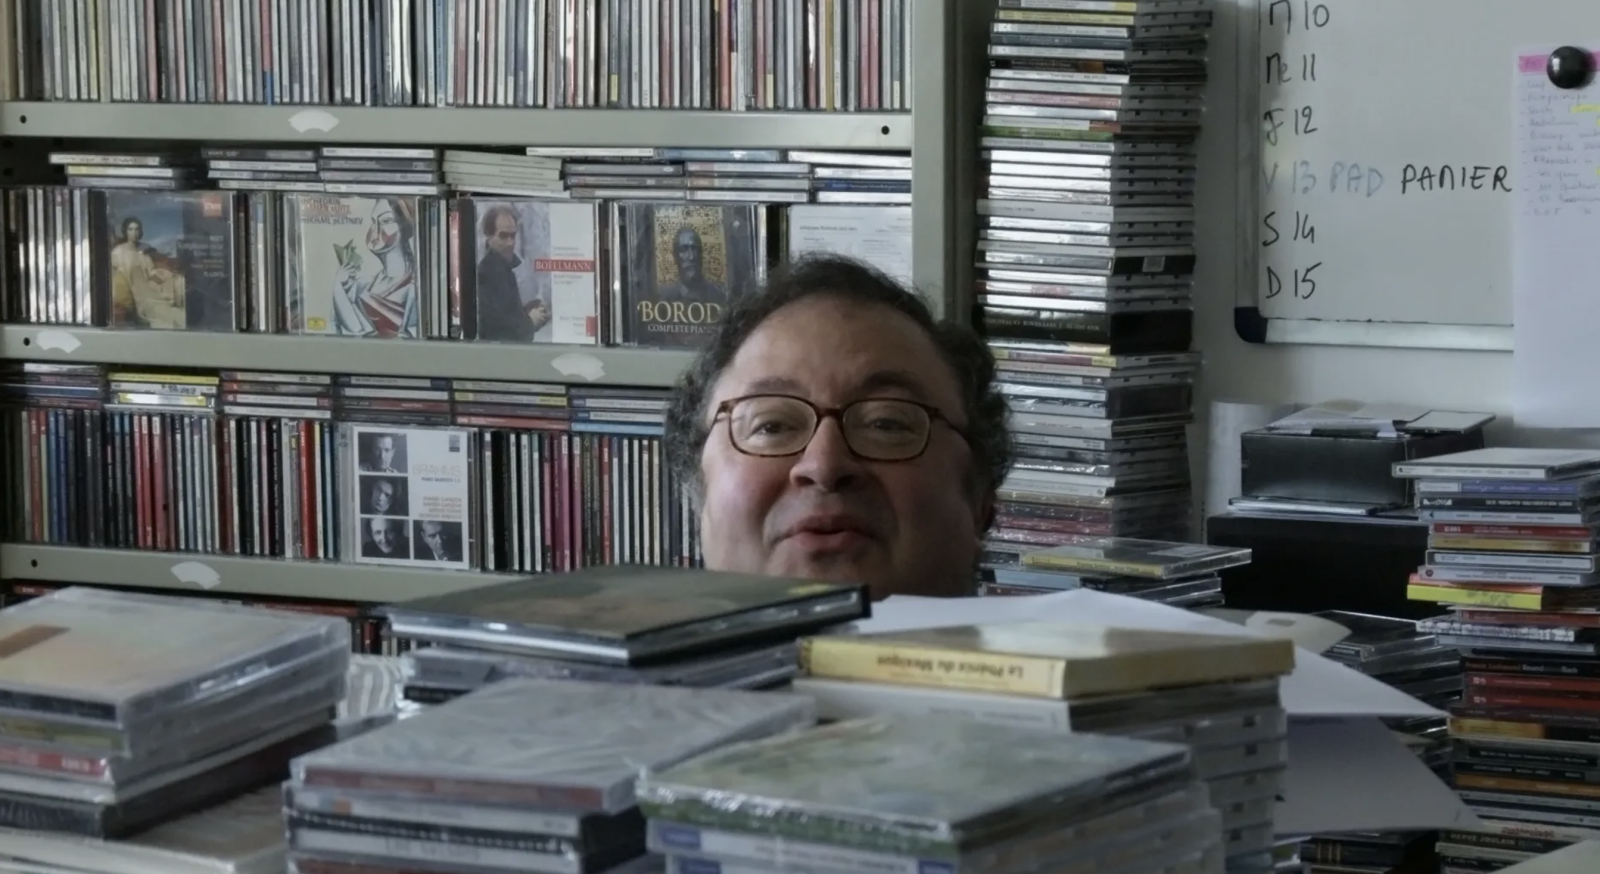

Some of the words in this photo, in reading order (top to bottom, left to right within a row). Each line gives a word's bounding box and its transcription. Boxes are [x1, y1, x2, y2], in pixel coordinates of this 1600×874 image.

[1303, 0, 1330, 30] 10
[1302, 53, 1316, 81] 11
[1294, 105, 1318, 135] 12
[1292, 160, 1317, 194] 13
[1329, 162, 1385, 198] PAD
[1400, 164, 1512, 194] PANIER
[1262, 211, 1279, 247] S
[1294, 211, 1315, 243] 14
[1265, 266, 1281, 299] D
[1294, 262, 1322, 300] 15
[648, 324, 688, 333] COMPLETE
[412, 464, 461, 477] BRAHMS
[877, 656, 933, 672] Mexique
[938, 661, 955, 674] du
[959, 663, 1004, 678] Phénix
[1008, 665, 1024, 679] Le
